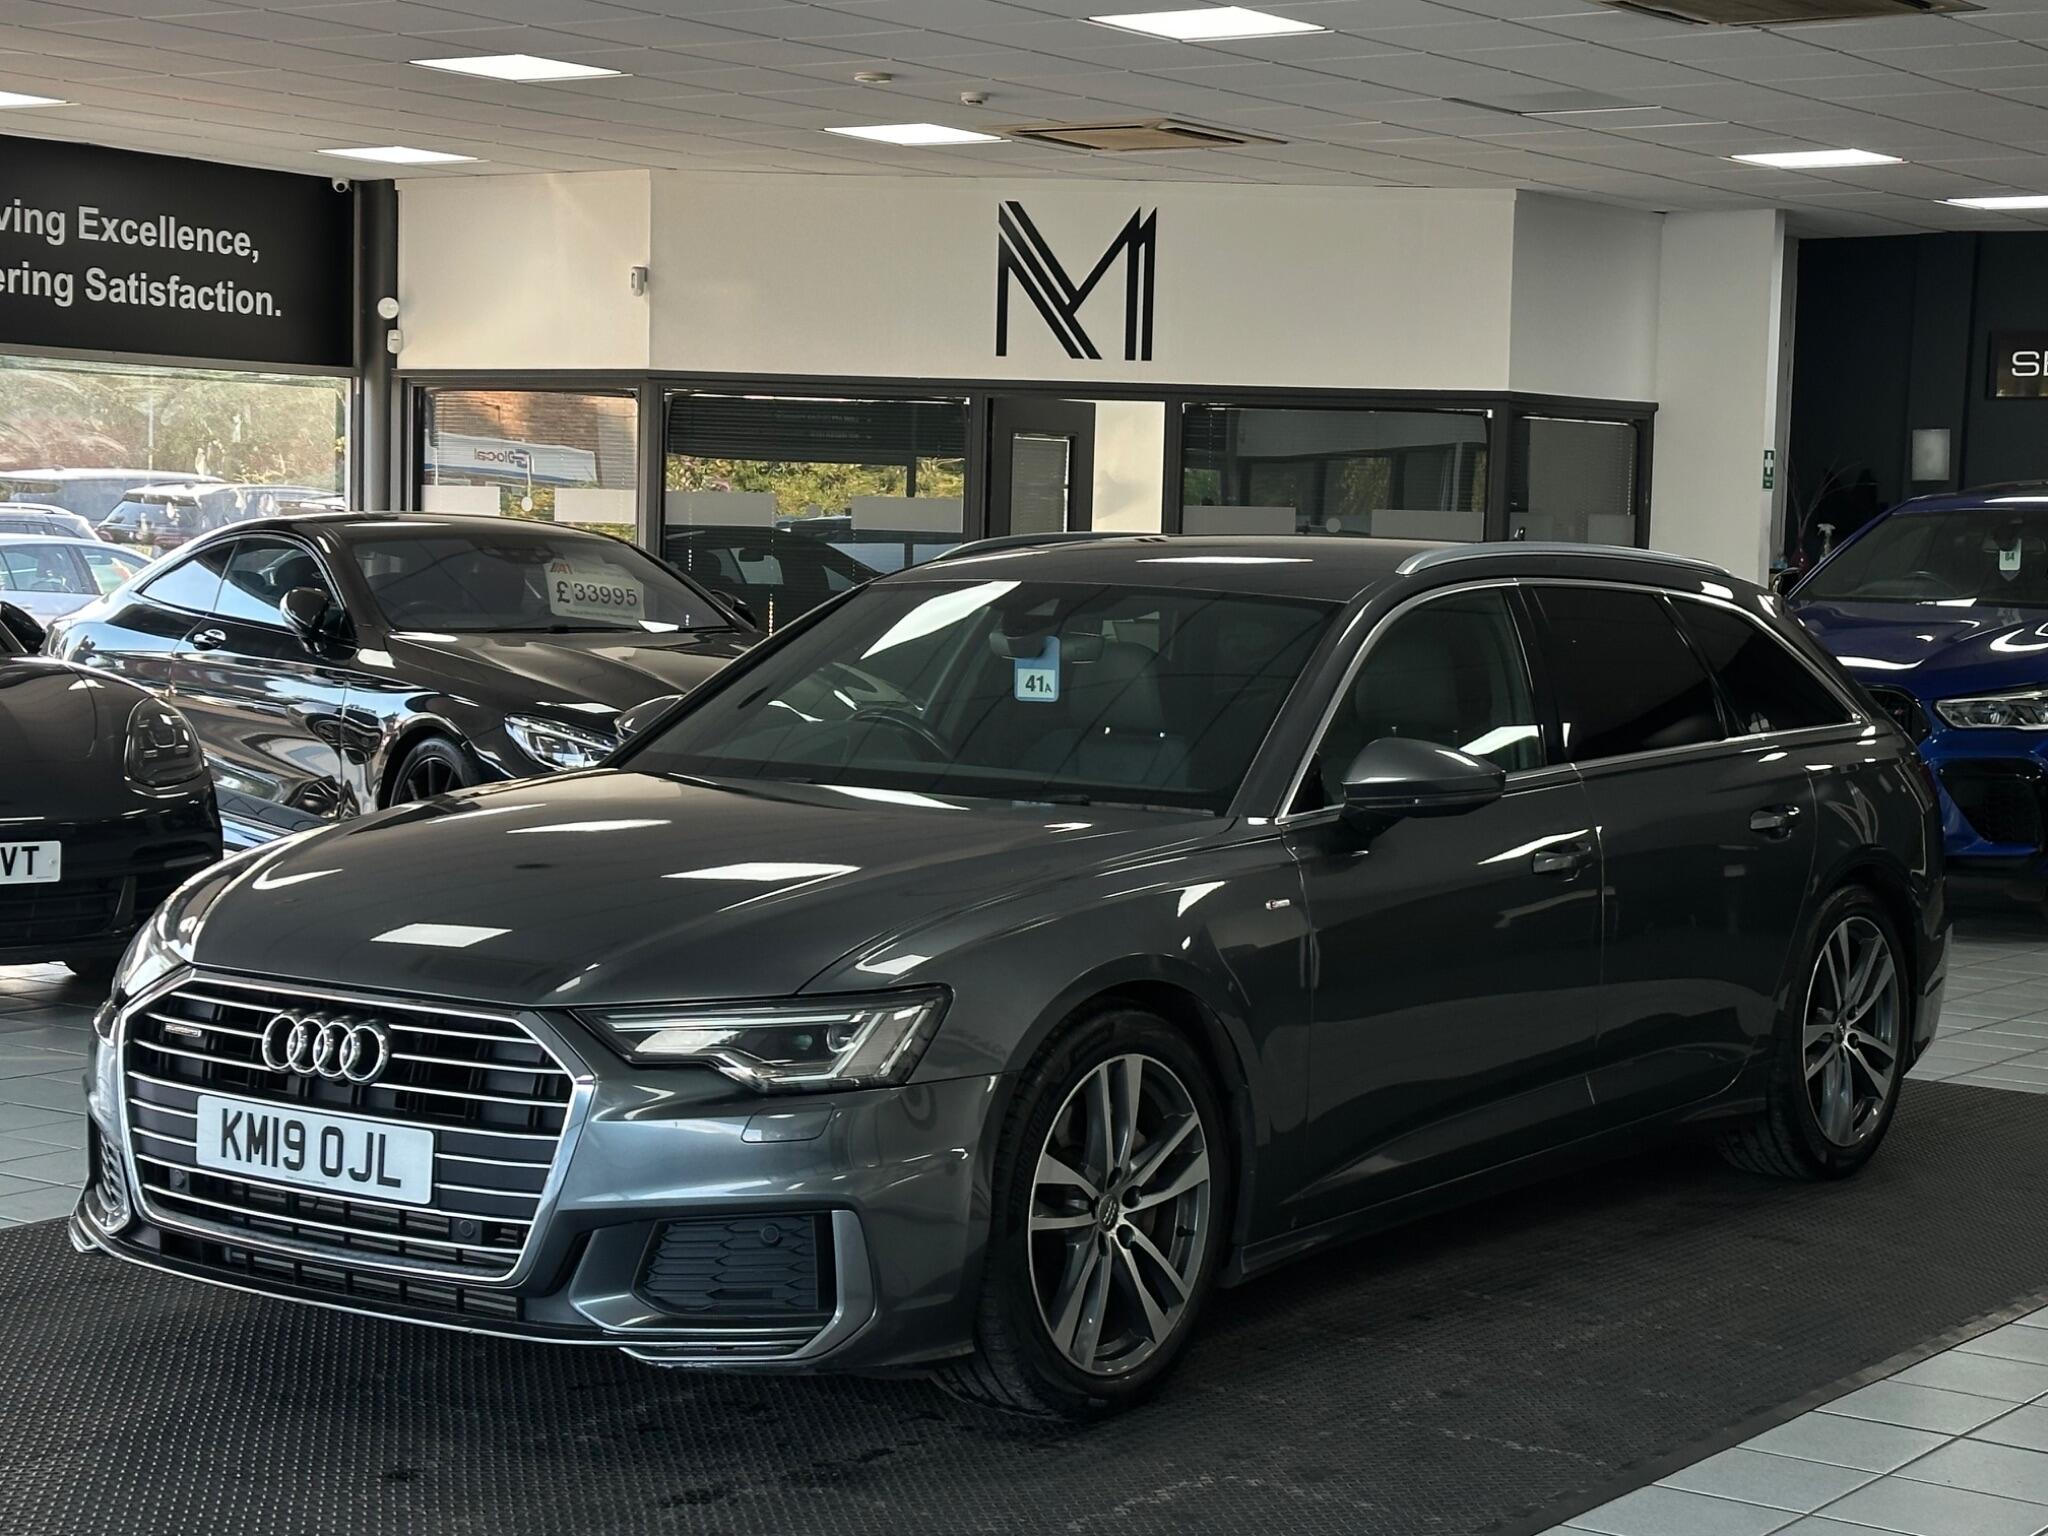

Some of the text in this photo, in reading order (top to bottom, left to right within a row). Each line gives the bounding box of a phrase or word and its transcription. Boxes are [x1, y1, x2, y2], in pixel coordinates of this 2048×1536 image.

[78, 206, 259, 263] Excellence,
[85, 267, 282, 317] Satisfaction.
[2012, 350, 2048, 378] S
[0, 846, 40, 877] VT
[220, 1108, 402, 1189] KM19 OJL
